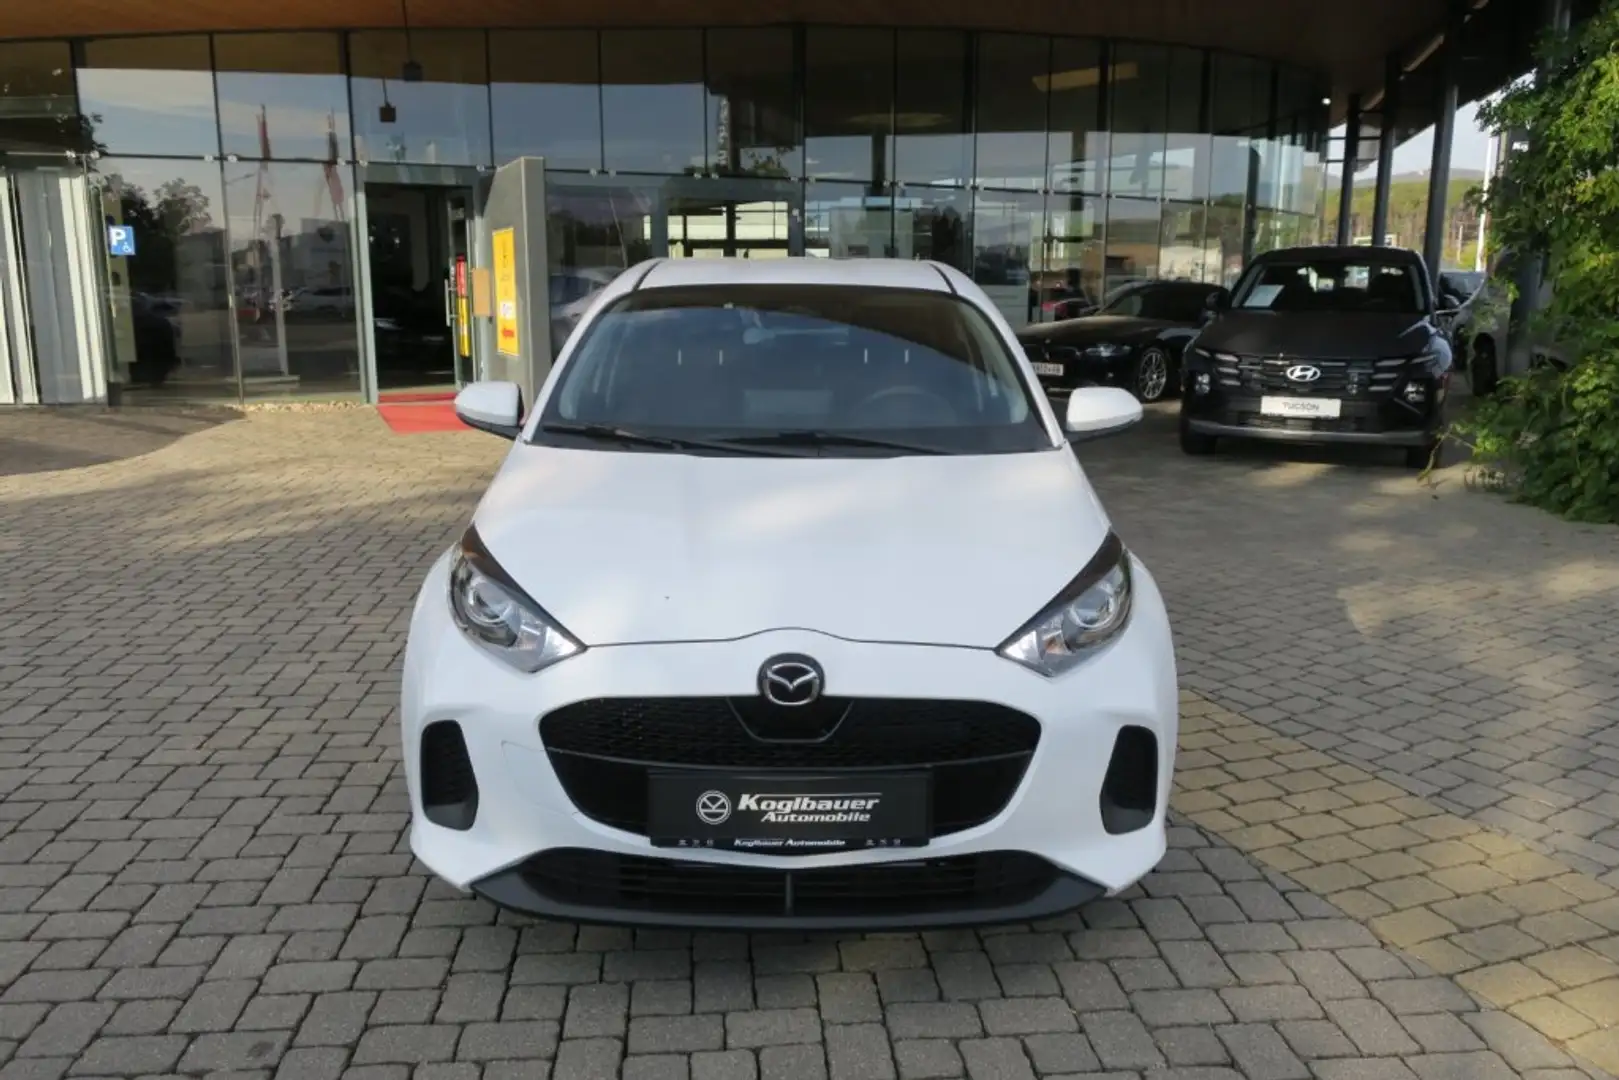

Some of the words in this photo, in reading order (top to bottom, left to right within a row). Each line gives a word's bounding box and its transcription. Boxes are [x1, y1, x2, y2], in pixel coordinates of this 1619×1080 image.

[110, 228, 125, 246] P
[1282, 402, 1320, 411] TUCSON
[737, 793, 880, 814] Koglbauer
[760, 811, 871, 822] Automobile
[786, 838, 846, 846] Automobile
